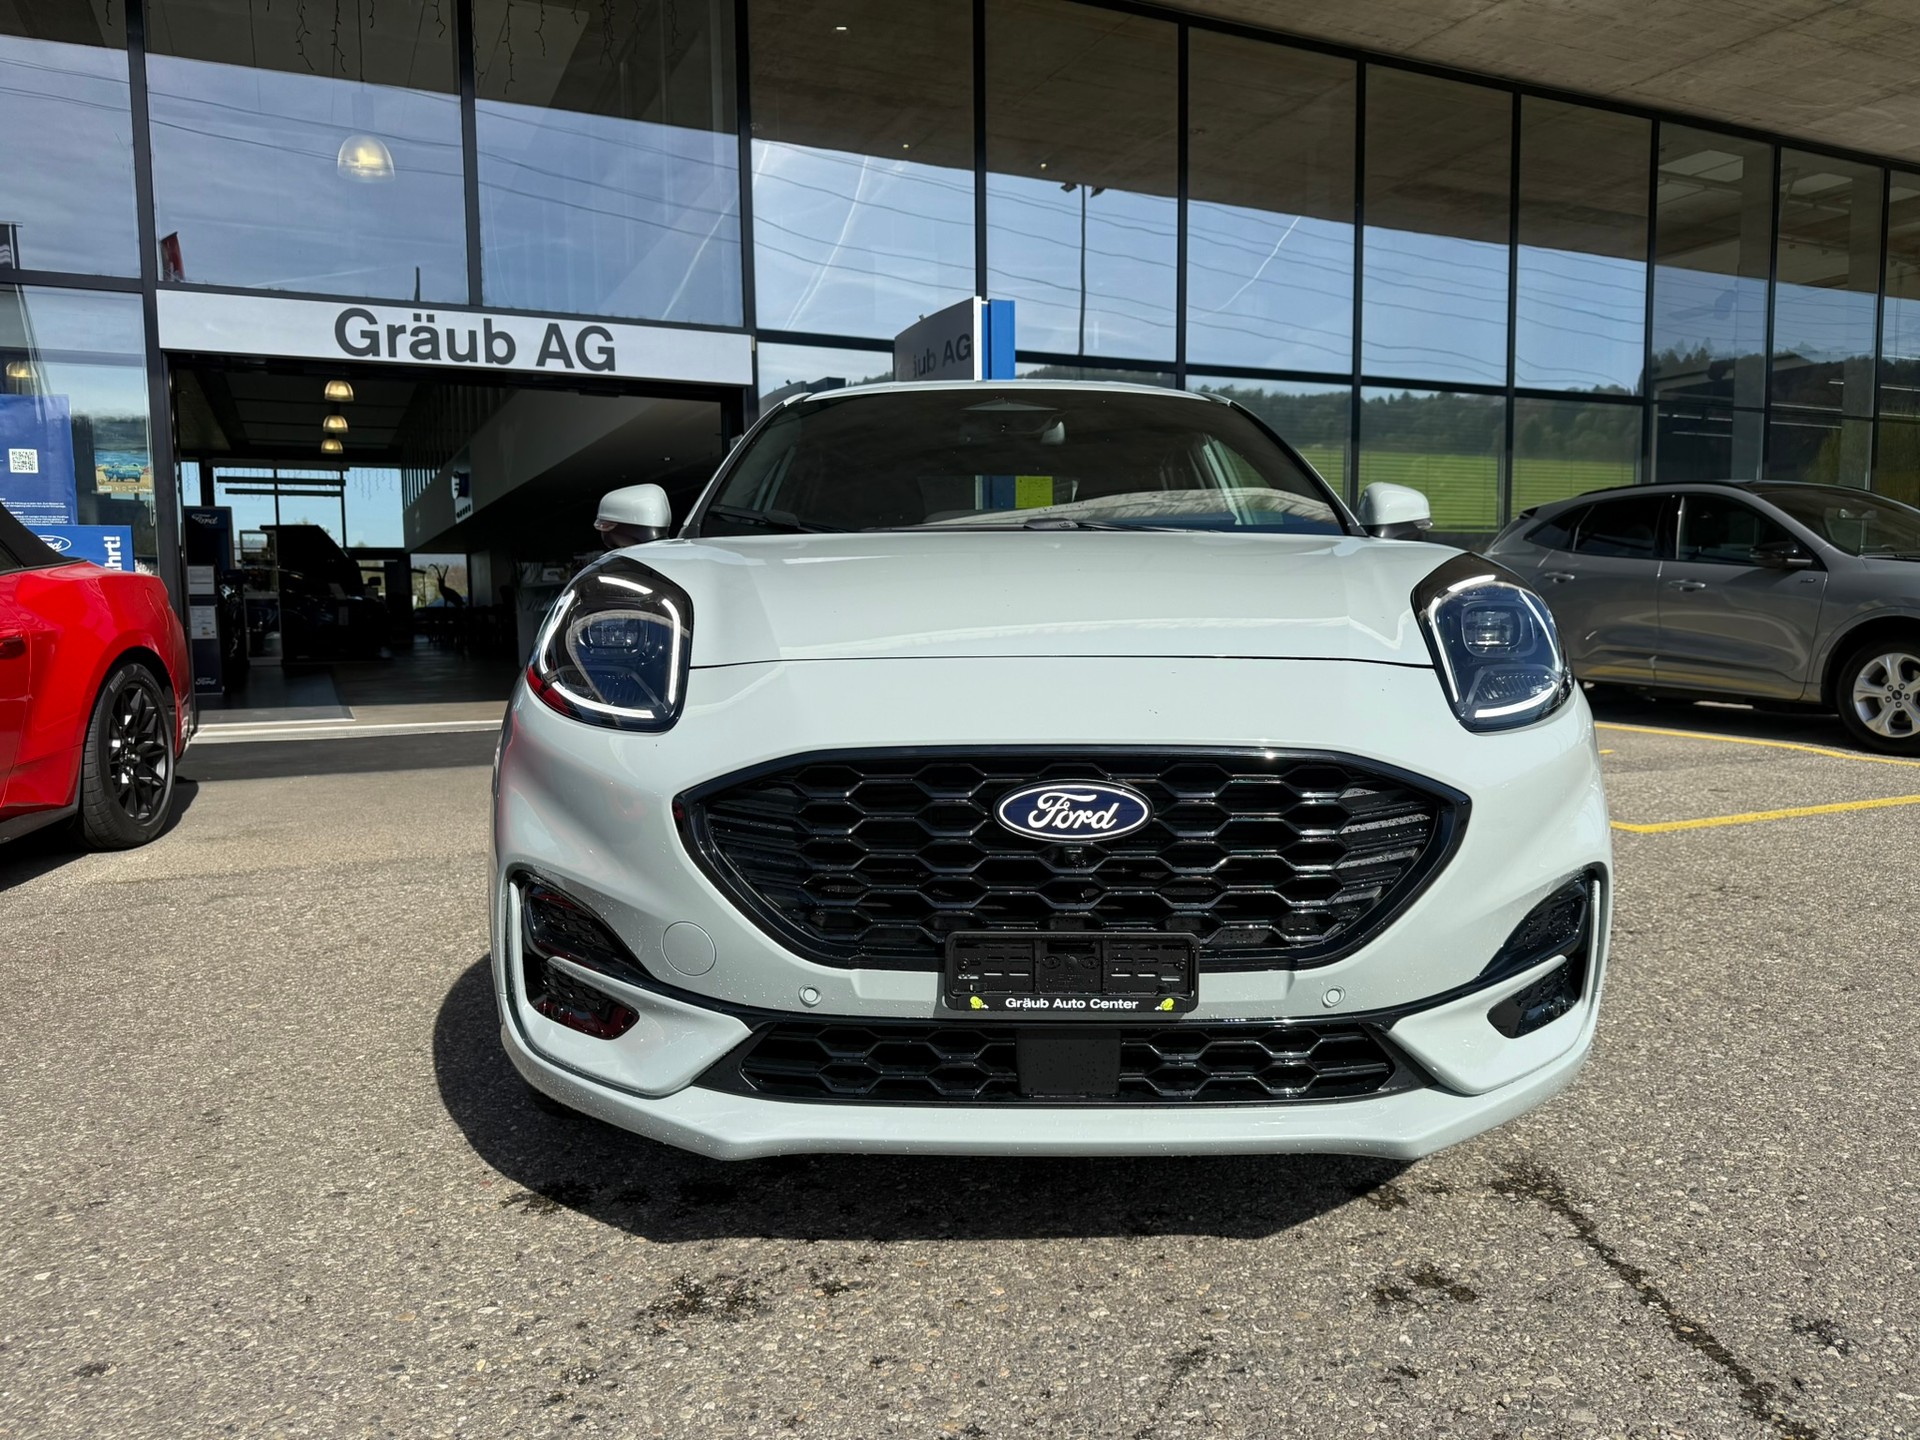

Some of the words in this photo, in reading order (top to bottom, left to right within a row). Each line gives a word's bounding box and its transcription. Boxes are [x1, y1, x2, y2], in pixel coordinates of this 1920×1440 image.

[335, 308, 517, 372] Gräub
[536, 323, 616, 372] AG
[942, 333, 971, 367] AG
[103, 536, 122, 571] hrt!
[1027, 792, 1120, 829] Ford
[1005, 998, 1049, 1009] Gräub
[1053, 999, 1085, 1009] Auto
[1089, 999, 1139, 1009] Center
